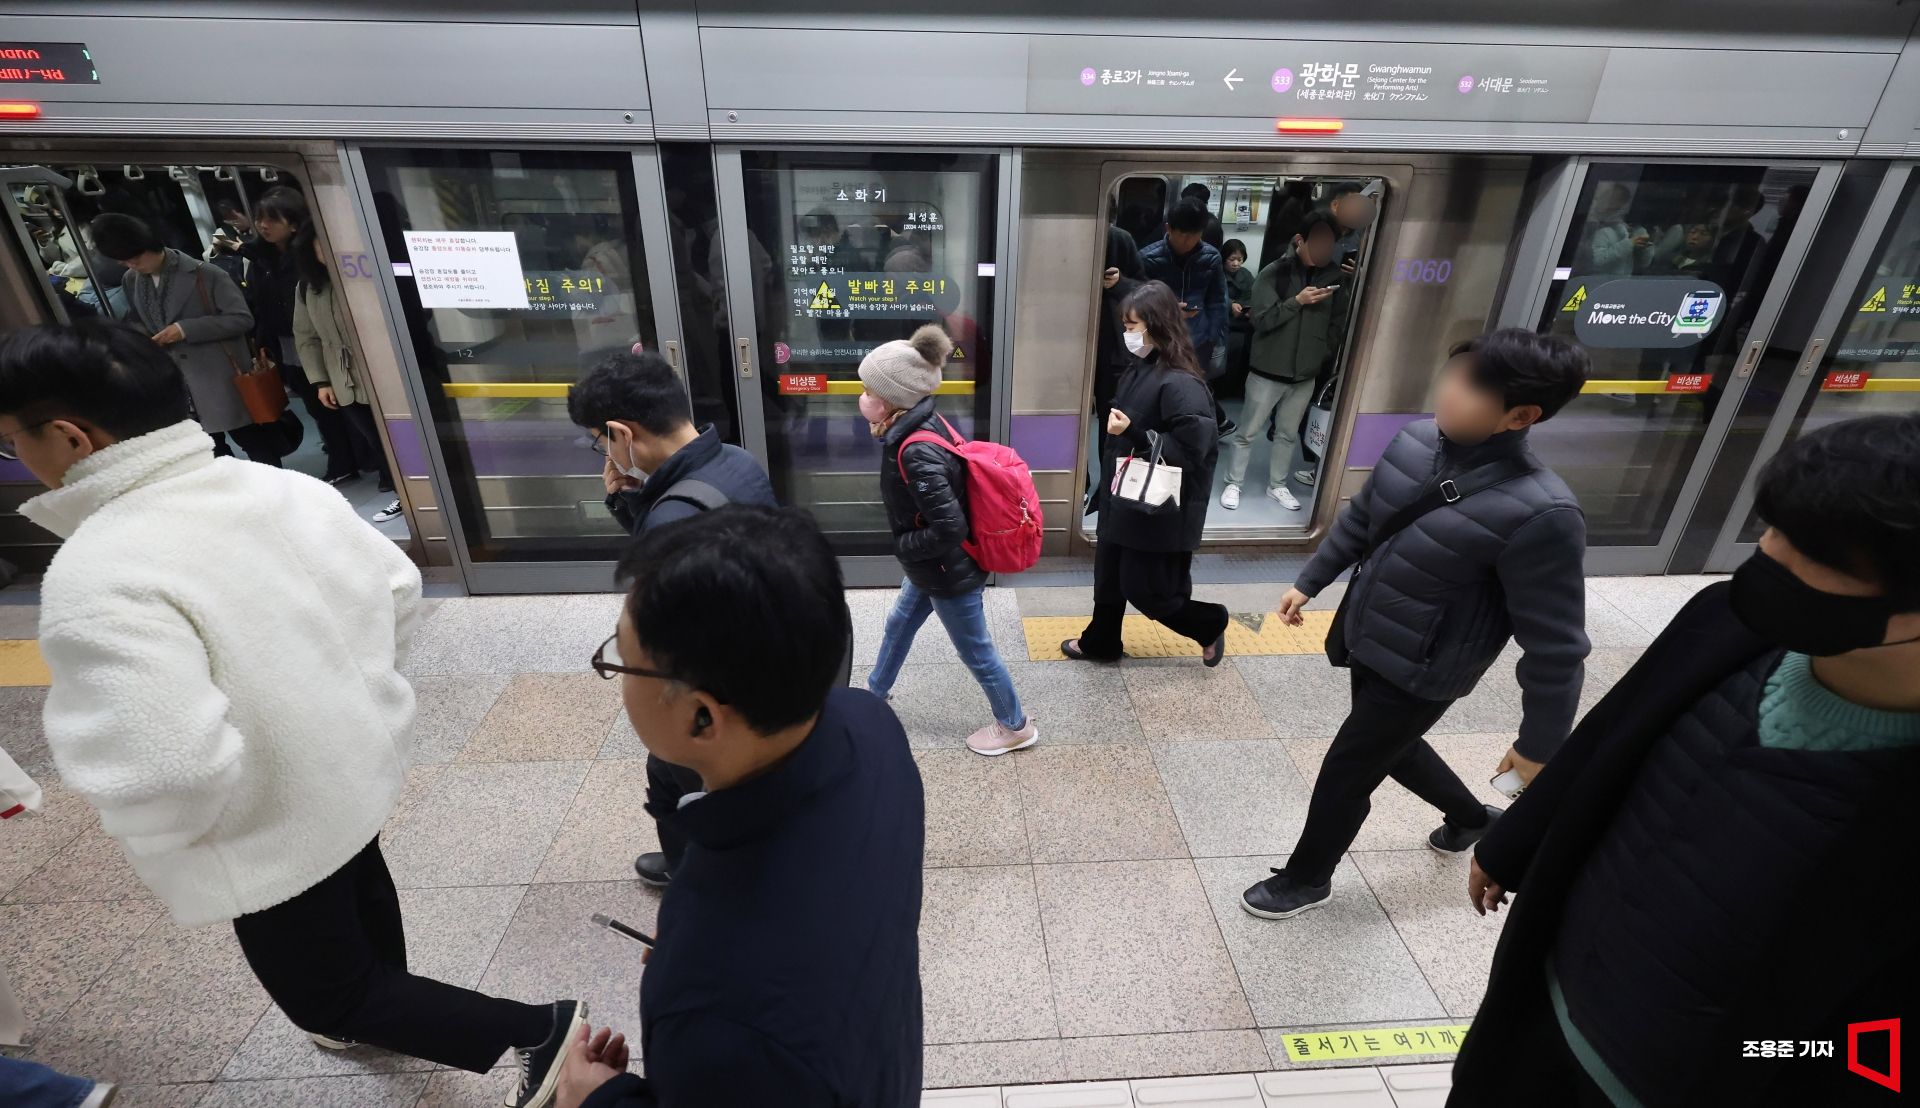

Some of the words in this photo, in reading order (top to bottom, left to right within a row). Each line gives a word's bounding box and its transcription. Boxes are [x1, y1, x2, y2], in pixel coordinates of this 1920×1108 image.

[1300, 62, 1360, 88] 광화문
[1369, 64, 1432, 75] Gwanghwamun
[1100, 69, 1142, 85] 종로3가
[1274, 76, 1290, 86] 533
[1478, 76, 1514, 93] 서대문
[1297, 89, 1356, 101] (세종문화회관)
[1393, 259, 1452, 283] 5060
[561, 278, 603, 293] 주의!
[848, 279, 894, 294] 발빠짐
[905, 279, 945, 294] 주의!
[1902, 284, 1920, 299] 발
[548, 303, 567, 311] 사이가
[869, 303, 888, 311] 승강장
[889, 303, 908, 311] 사이가
[1587, 311, 1627, 324] Move
[1628, 314, 1647, 324] the
[1648, 311, 1676, 326] City
[456, 349, 475, 358] 1-2
[789, 376, 817, 386] 비상문
[1677, 375, 1702, 386] 비상문
[1835, 374, 1860, 384] 비상문
[1293, 1034, 1381, 1056] 줄서기는
[1393, 1030, 1468, 1050] 여기까
